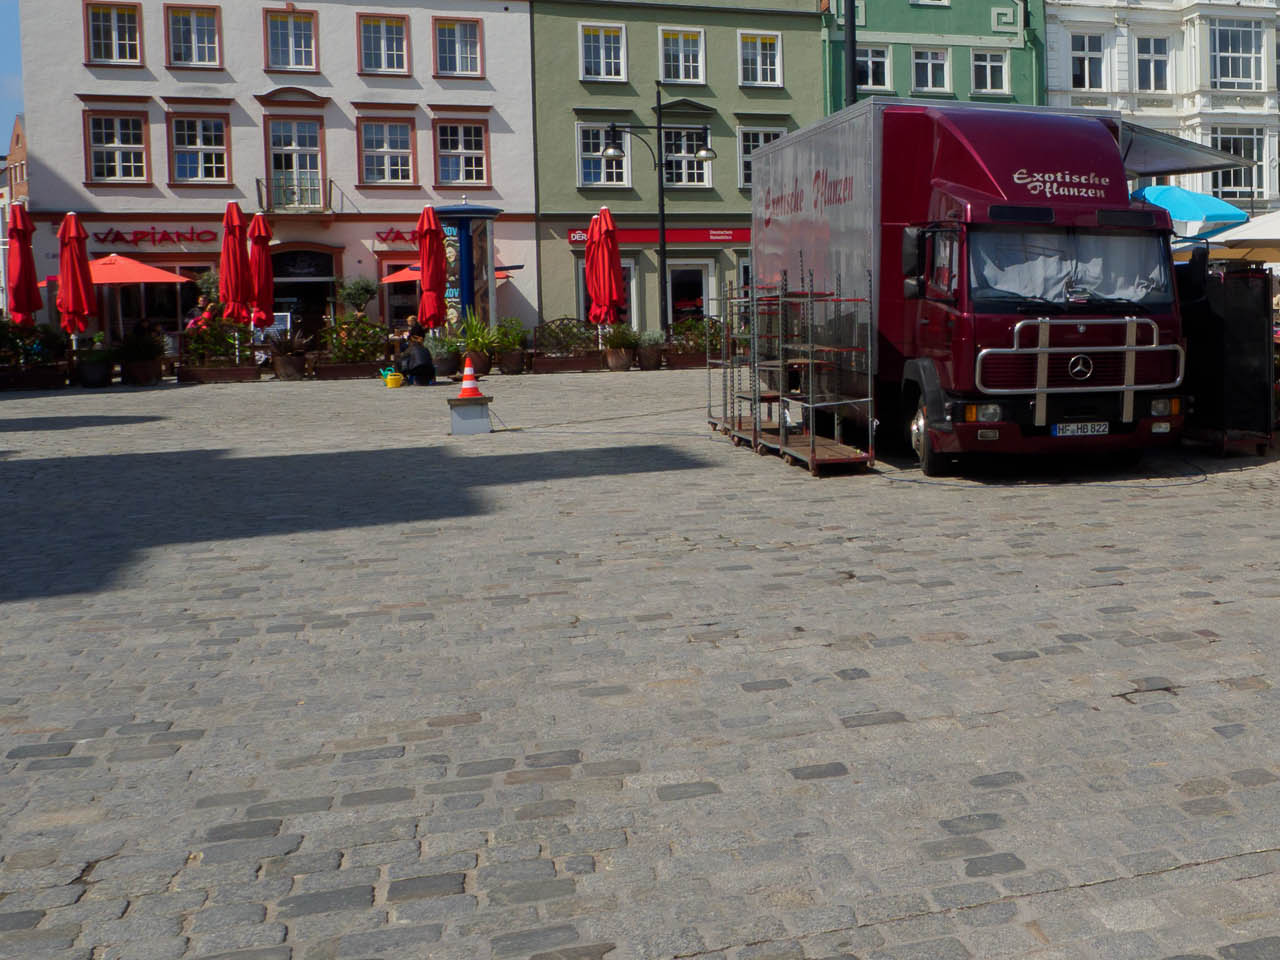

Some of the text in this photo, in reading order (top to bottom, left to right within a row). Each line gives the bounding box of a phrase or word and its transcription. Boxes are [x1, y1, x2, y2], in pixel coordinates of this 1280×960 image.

[1012, 169, 1110, 186] Exotische
[1027, 182, 1105, 198] Pflanzen
[1076, 423, 1089, 434] HB
[1090, 423, 1108, 433] 822
